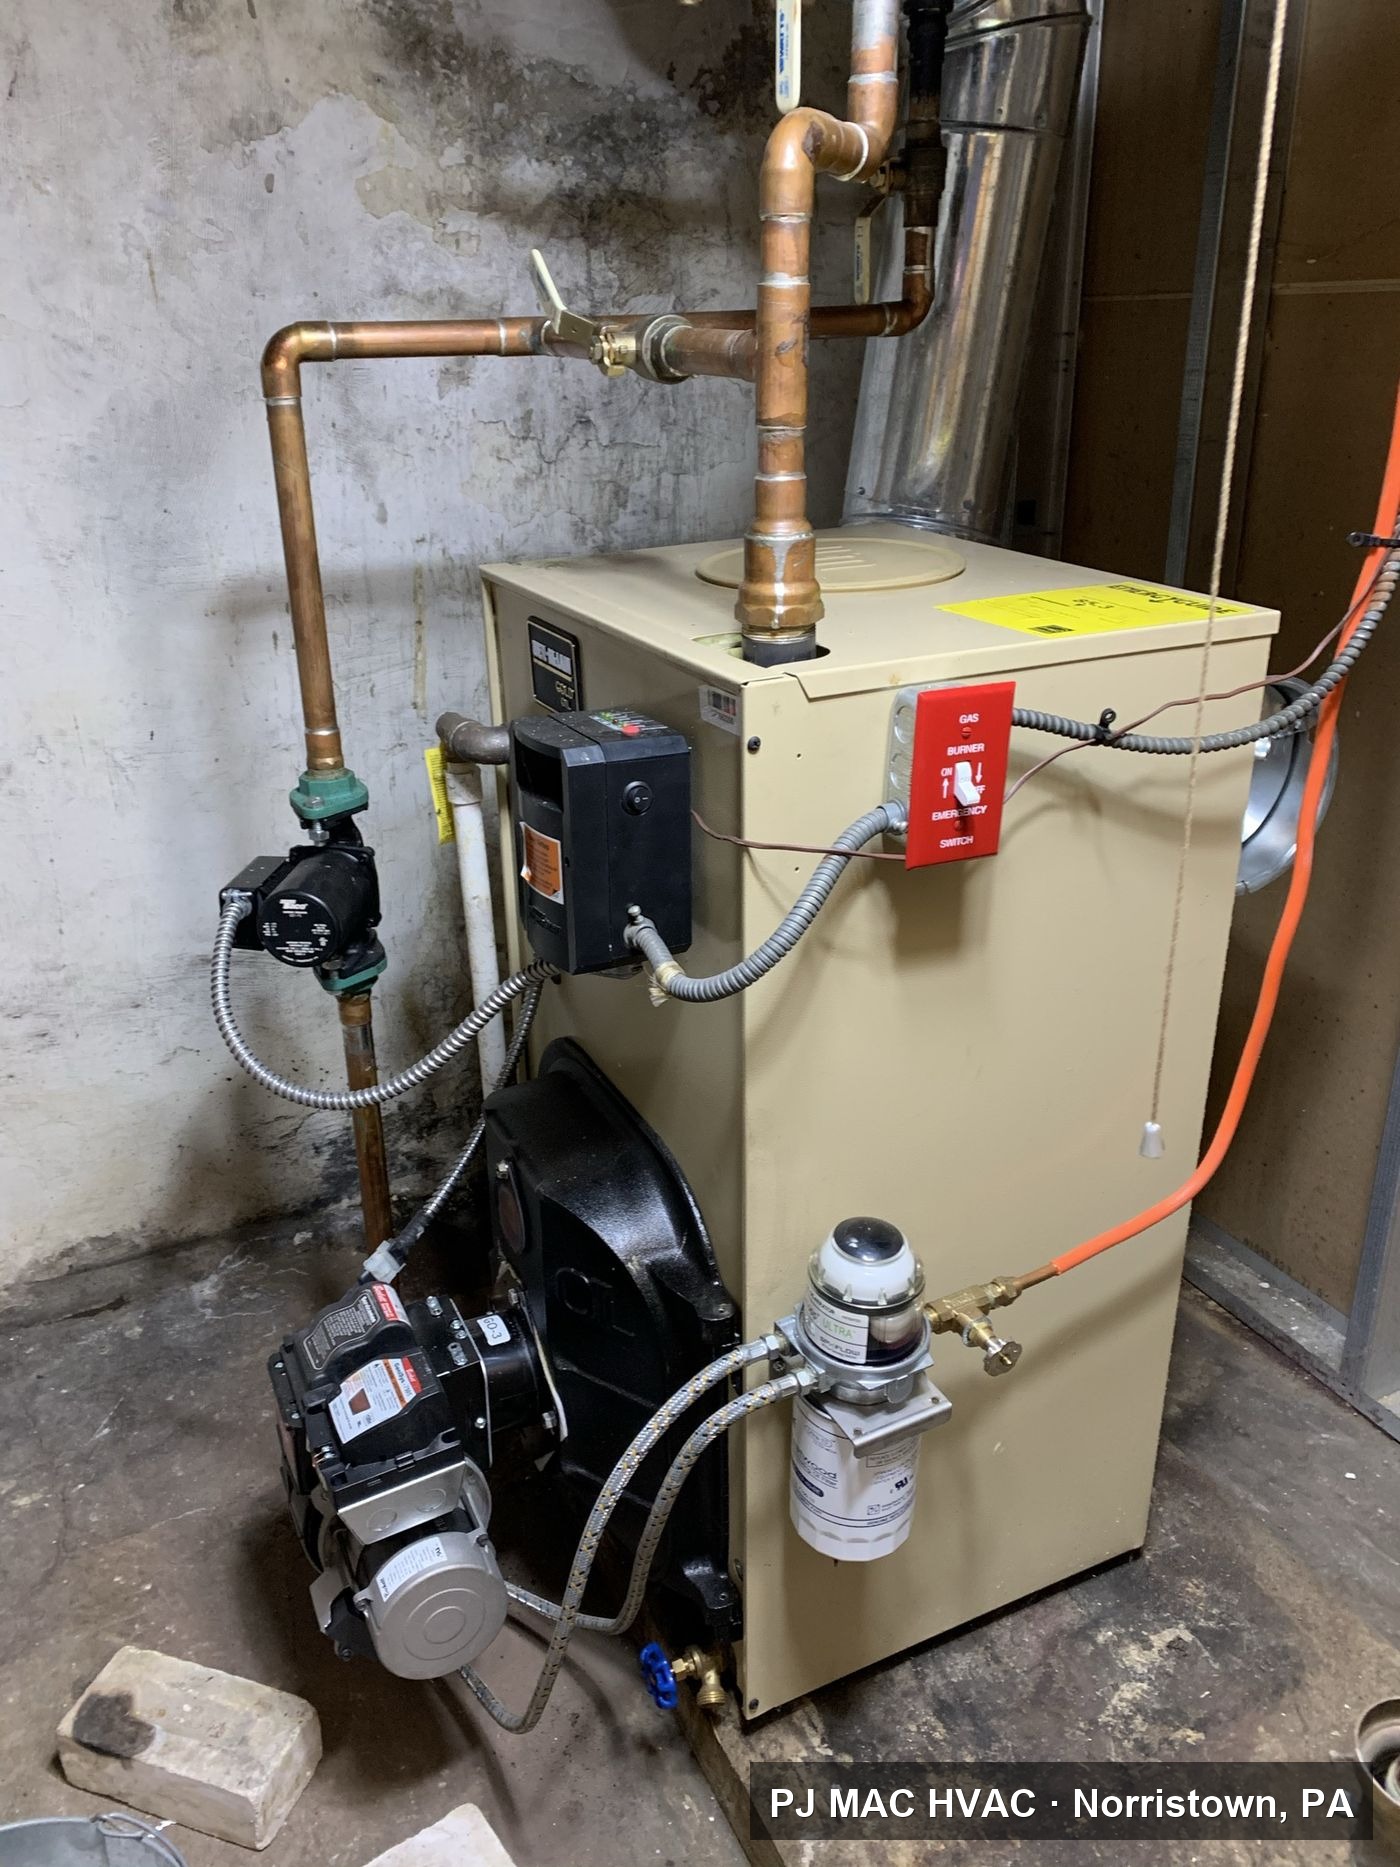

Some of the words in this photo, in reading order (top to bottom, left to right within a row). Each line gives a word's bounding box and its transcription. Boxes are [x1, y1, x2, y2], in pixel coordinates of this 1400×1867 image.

[959, 713, 979, 724] GAS
[947, 743, 985, 756] BURNER
[941, 767, 953, 777] ON
[932, 805, 988, 821] EMERGENCY
[939, 836, 974, 849] SWITCH
